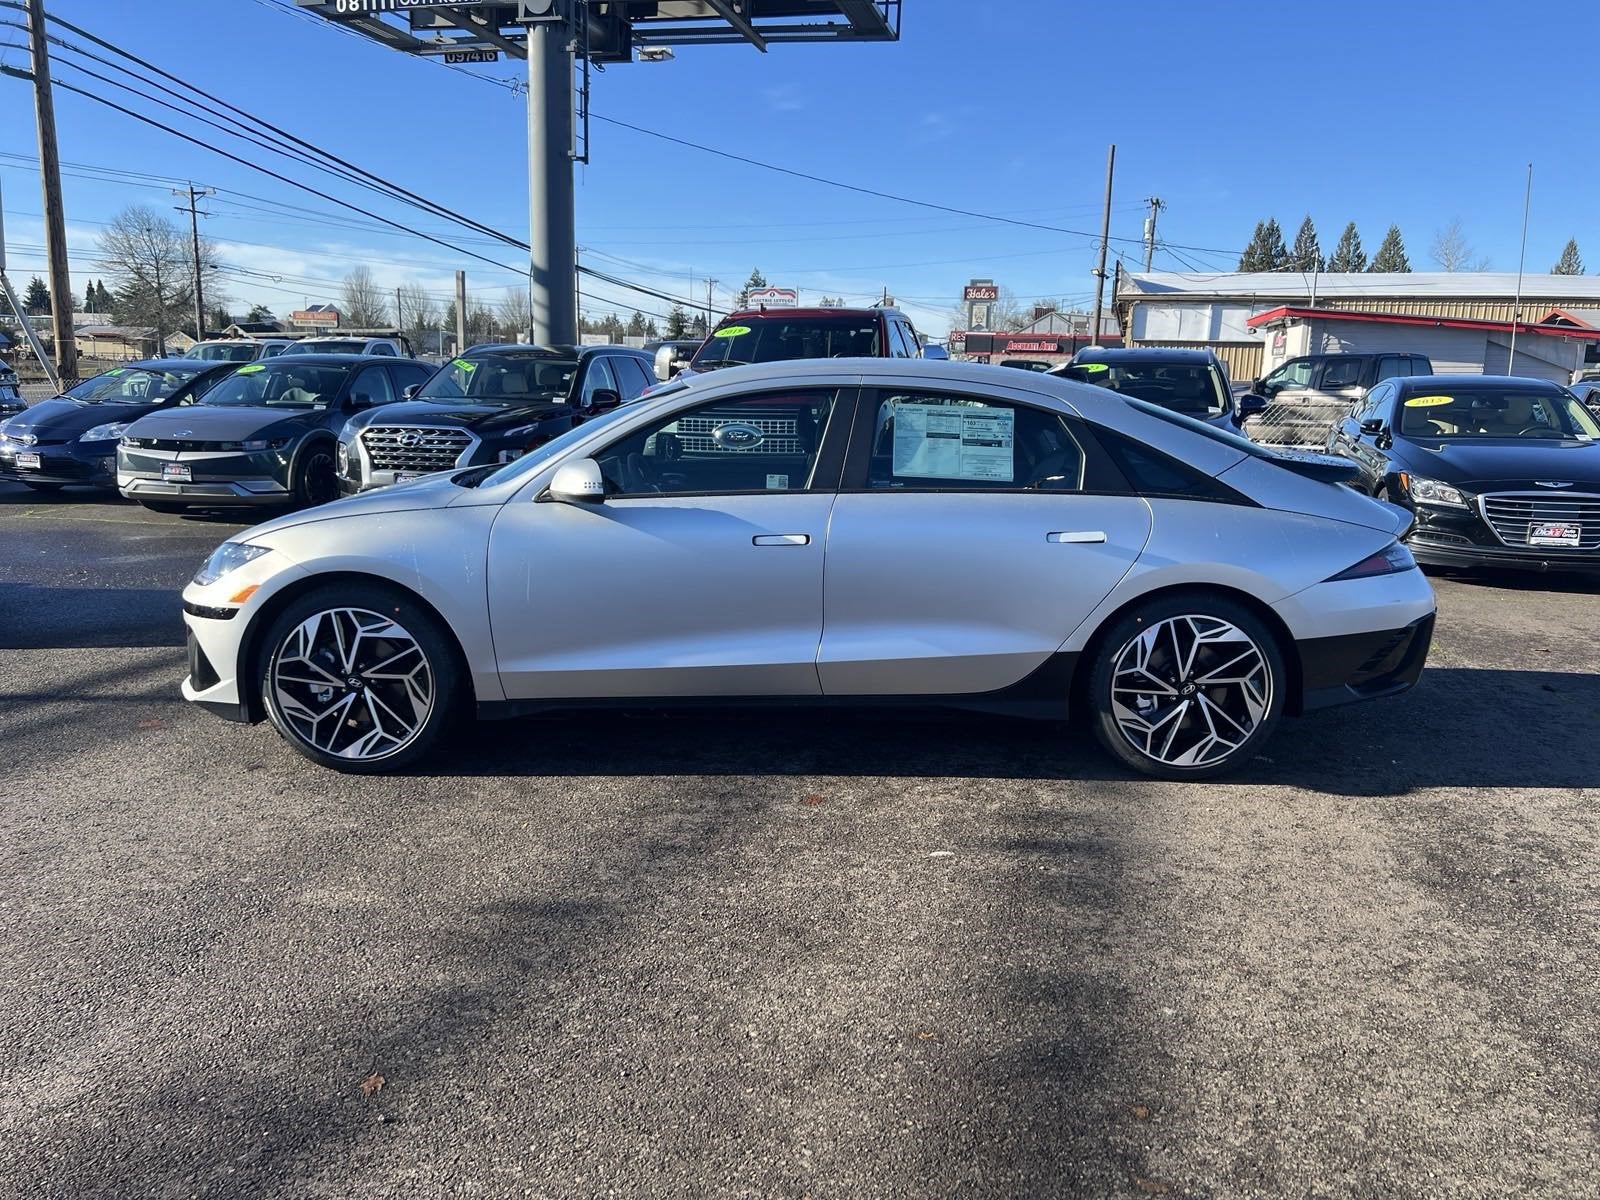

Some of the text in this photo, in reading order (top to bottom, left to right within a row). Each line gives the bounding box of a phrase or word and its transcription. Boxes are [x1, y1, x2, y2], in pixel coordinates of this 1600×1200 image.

[966, 288, 995, 298] Hale's
[1039, 340, 1057, 351] AUTO
[1414, 397, 1443, 405] 2015
